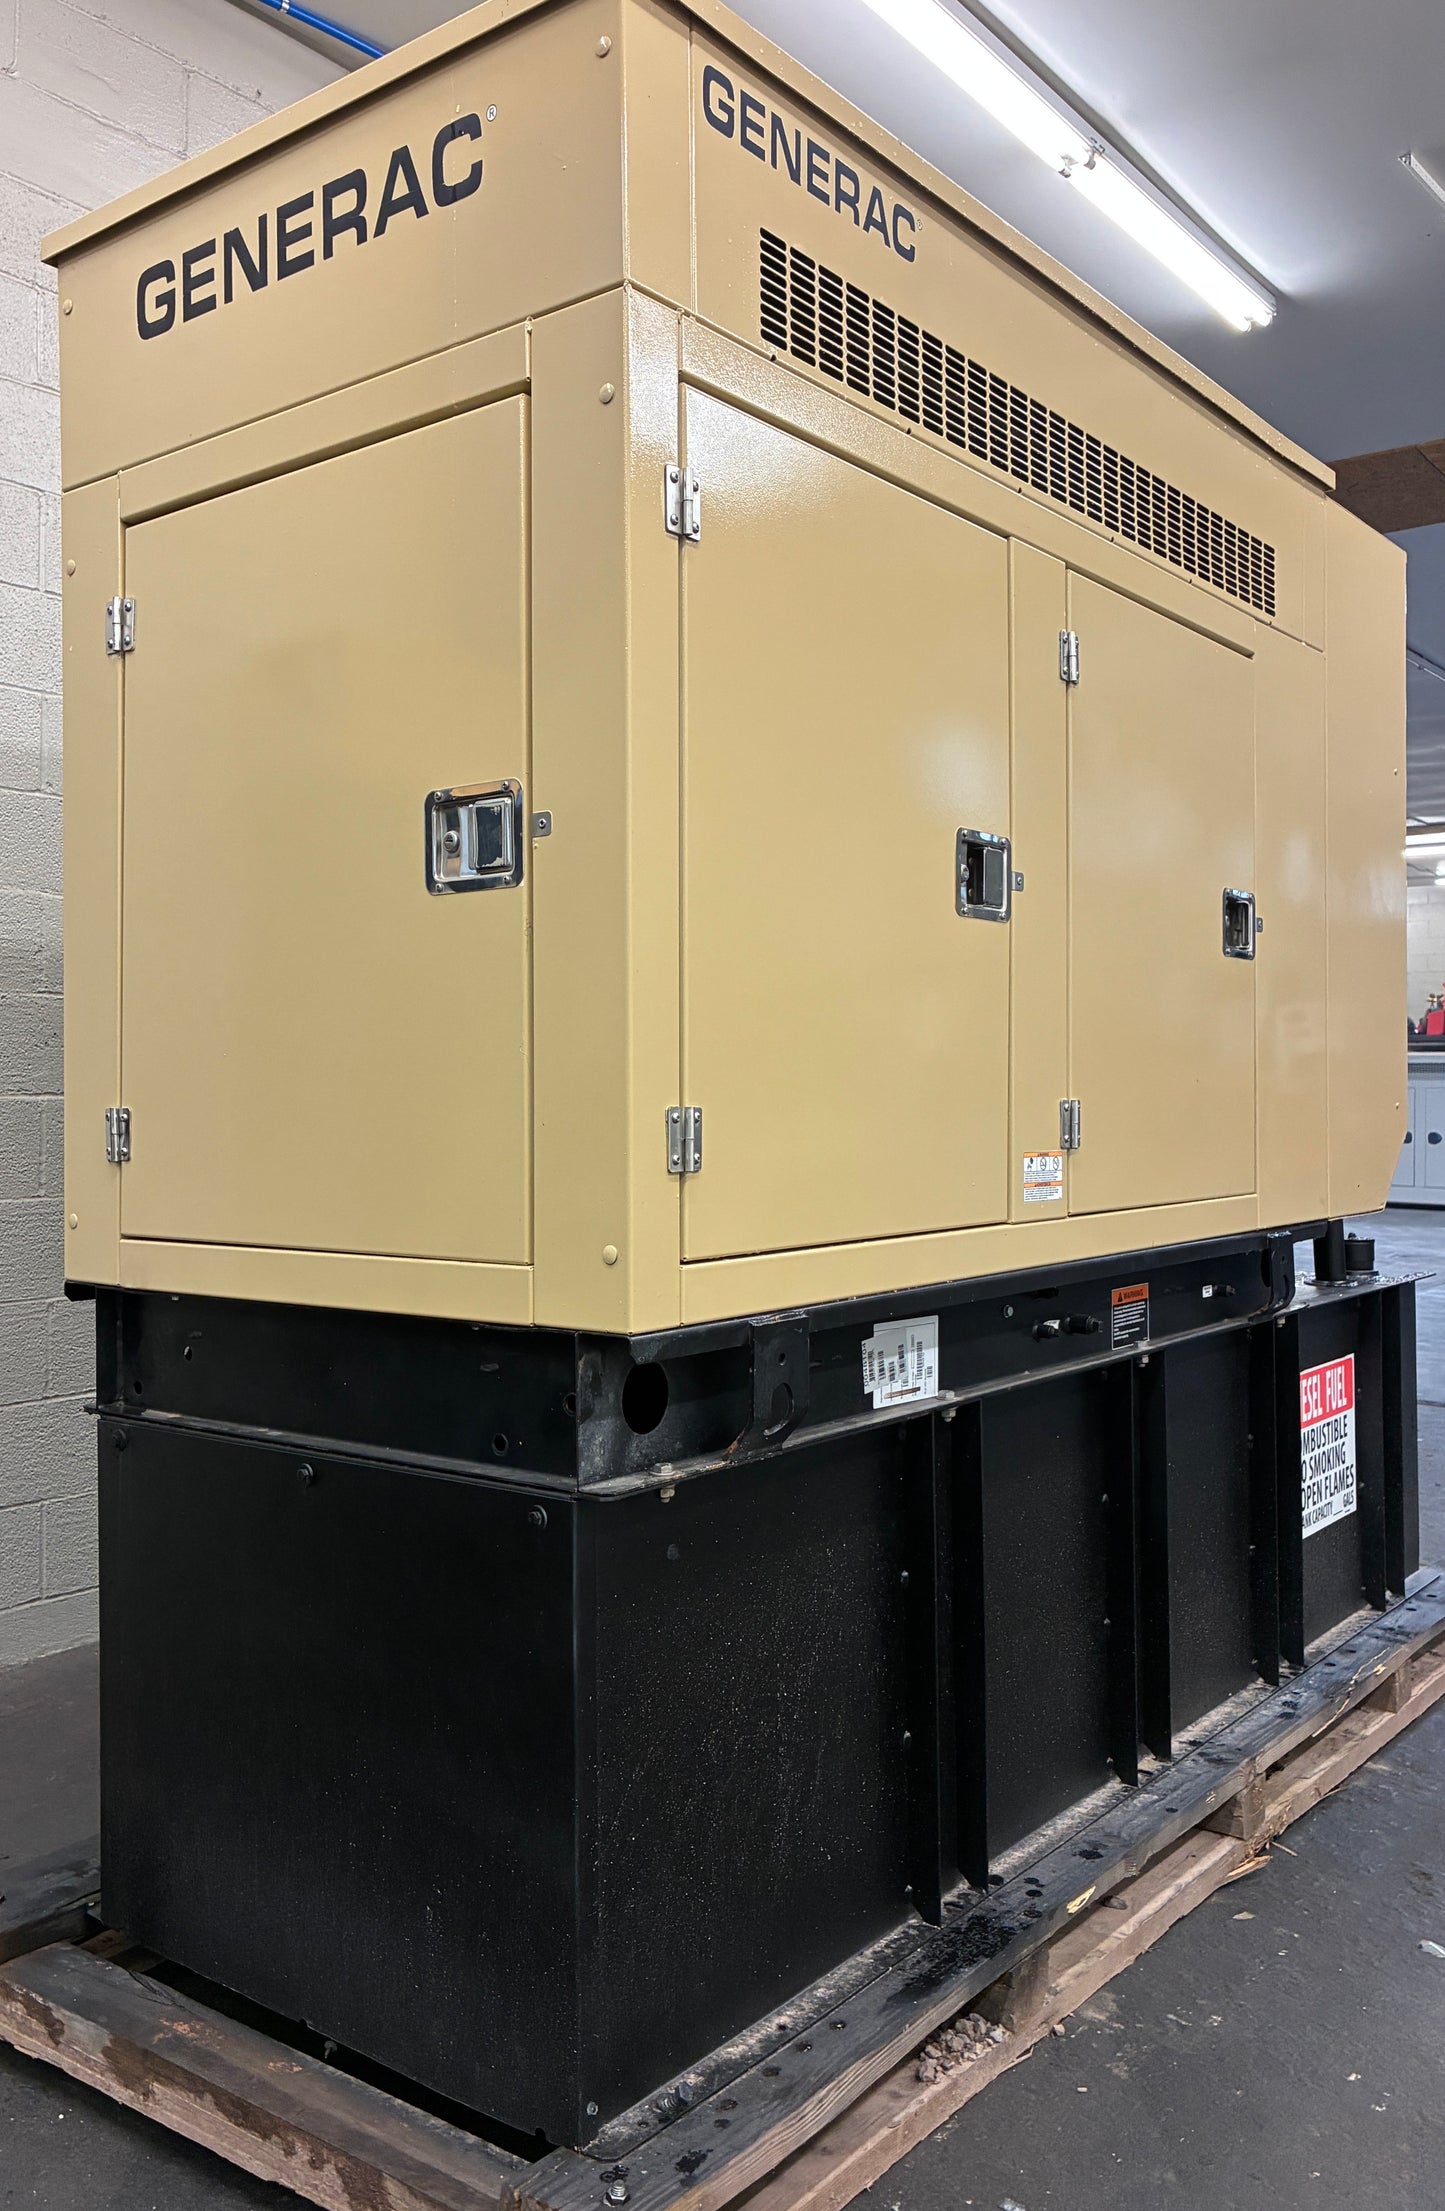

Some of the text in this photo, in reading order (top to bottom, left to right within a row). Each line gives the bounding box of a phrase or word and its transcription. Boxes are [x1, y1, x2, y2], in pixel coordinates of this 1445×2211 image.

[703, 64, 917, 264] GENERAC
[136, 111, 484, 340] GENERAC
[1326, 1365, 1348, 1413] FUEL
[1301, 1414, 1348, 1456] MBUSTIBLE
[1309, 1441, 1346, 1480] SMOKING
[1301, 1464, 1354, 1511] OPEN FLAMES
[1312, 1500, 1333, 1524] CAPACITY
[1343, 1490, 1354, 1507] GALS
